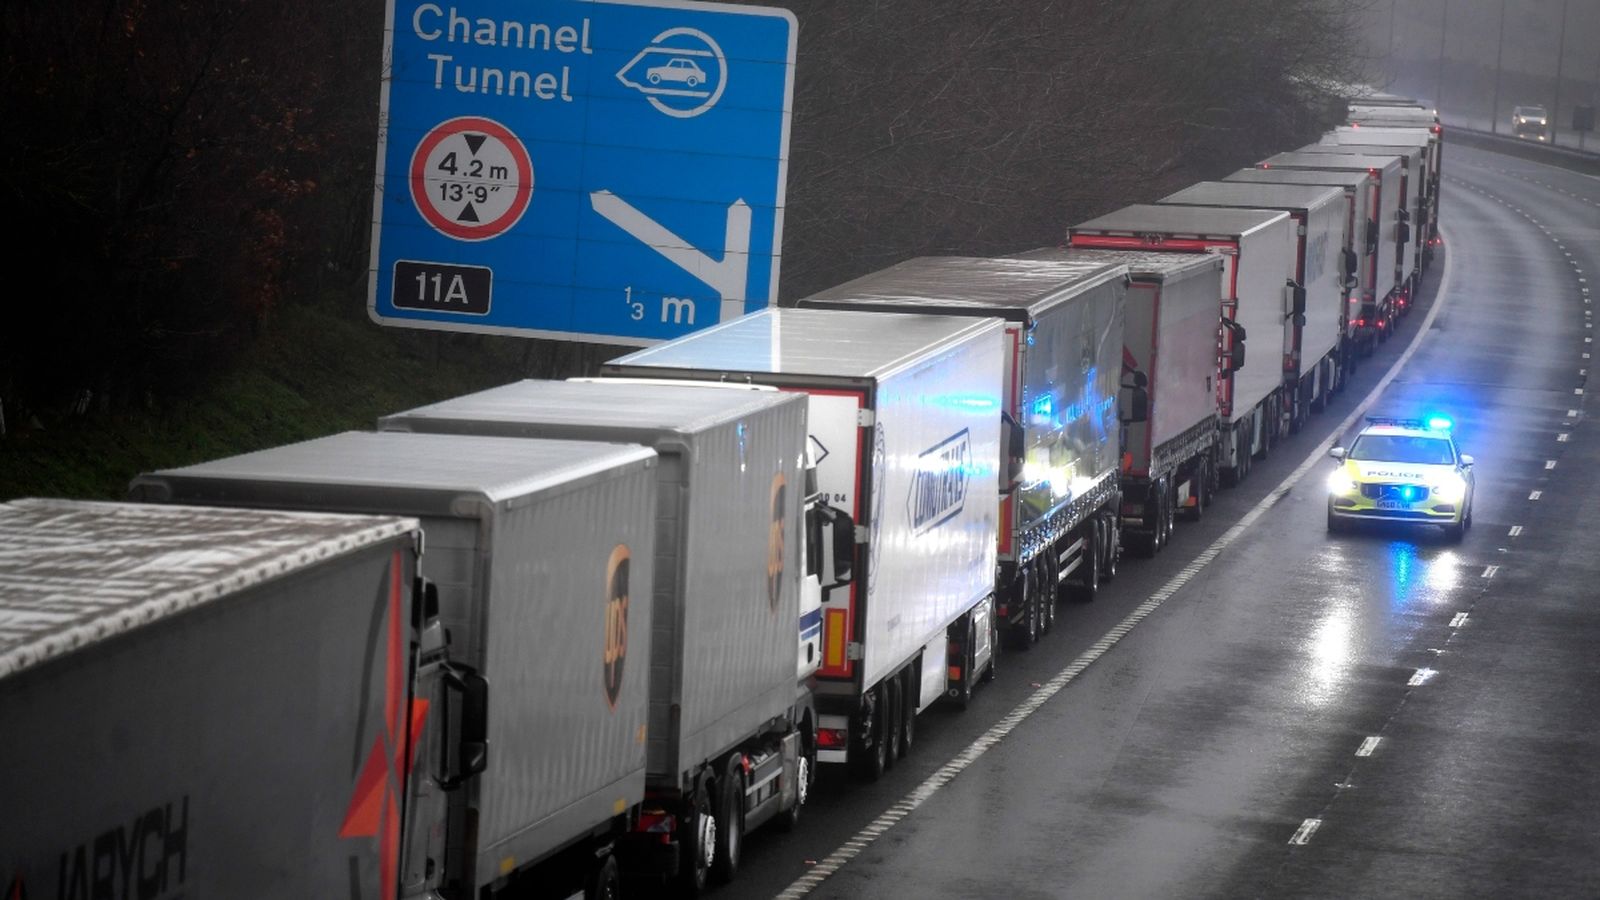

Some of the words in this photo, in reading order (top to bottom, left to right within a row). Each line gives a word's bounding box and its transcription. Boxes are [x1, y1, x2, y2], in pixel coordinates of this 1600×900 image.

[412, 3, 593, 55] Channel
[427, 53, 573, 102] Tunnel
[438, 151, 483, 178] 4.2
[489, 165, 508, 180] m
[415, 271, 469, 304] 11A
[660, 297, 696, 325] m
[1367, 470, 1425, 479] POLICE
[834, 493, 846, 503] 04
